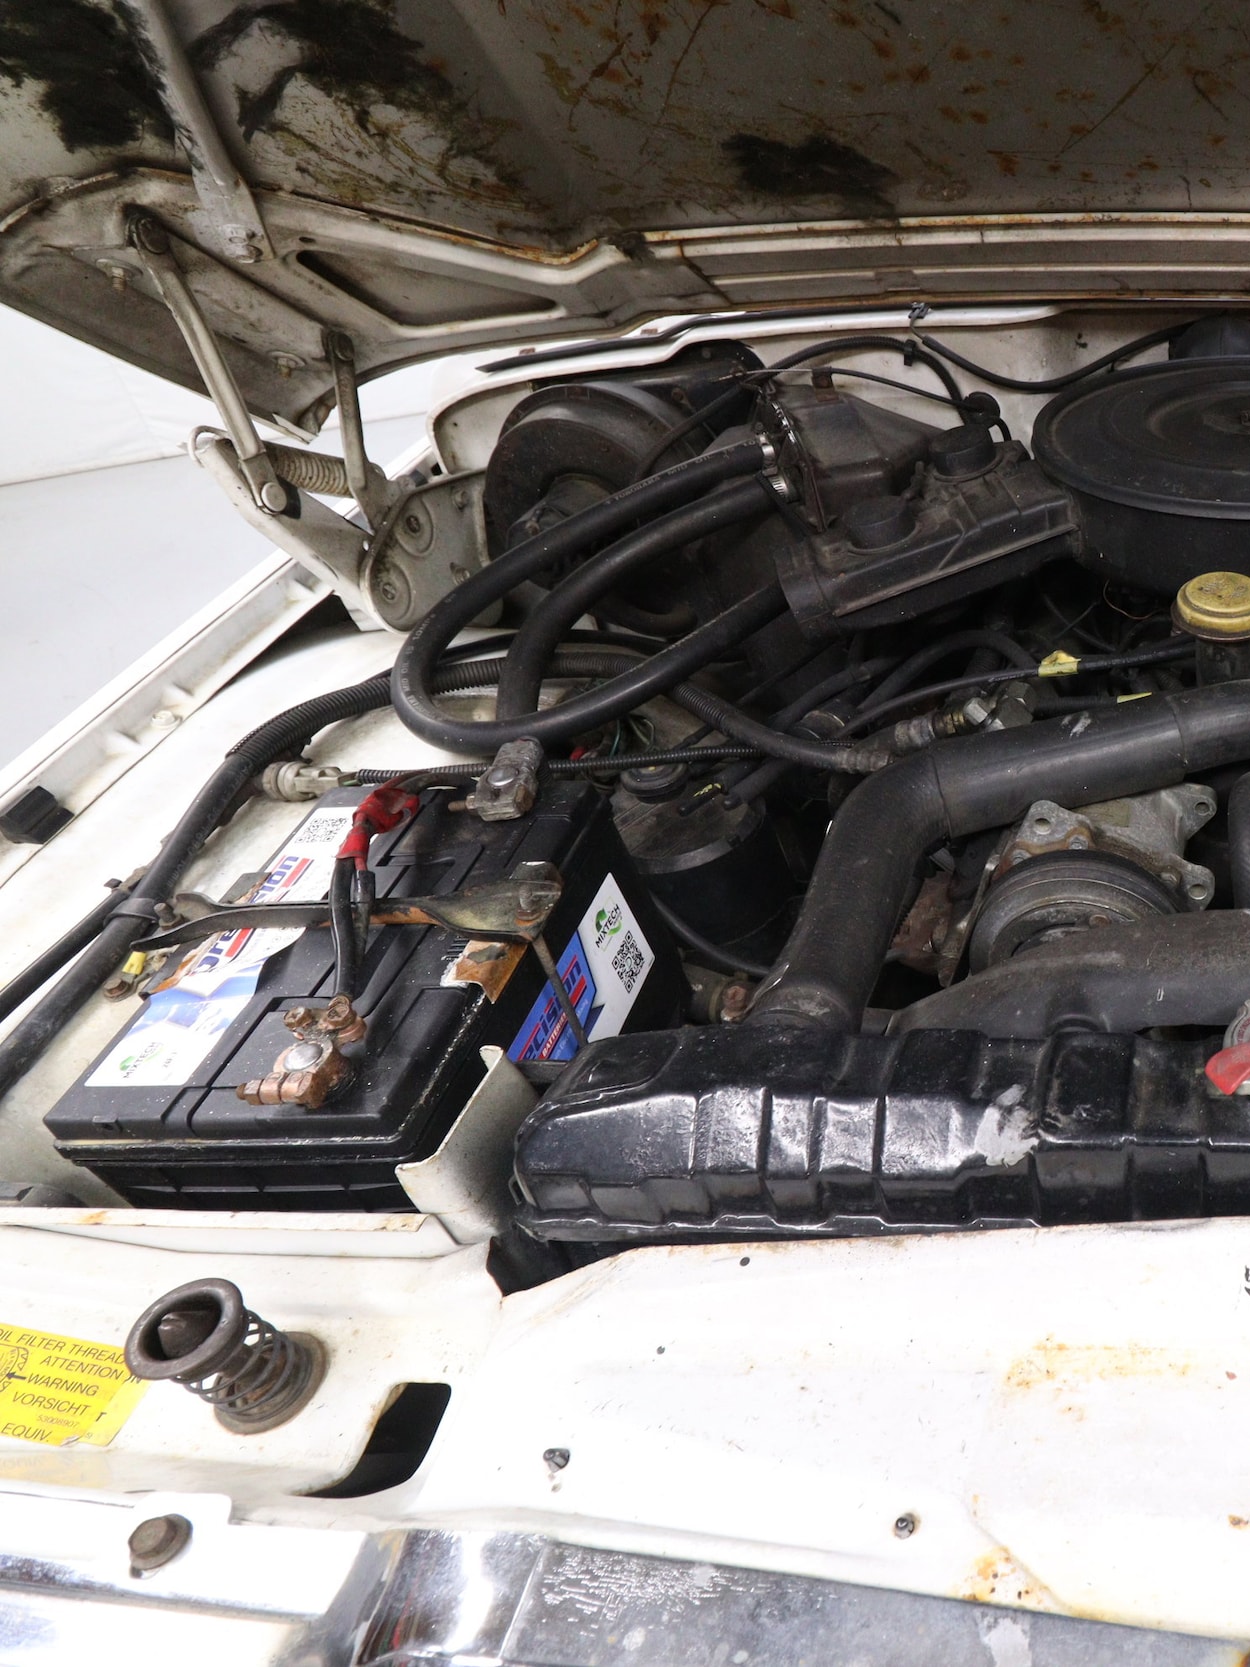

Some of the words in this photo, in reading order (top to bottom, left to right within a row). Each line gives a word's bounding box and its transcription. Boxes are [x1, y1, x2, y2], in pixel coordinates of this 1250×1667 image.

[594, 903, 621, 949] MIXTECH
[122, 1041, 158, 1079] MIXTECH
[16, 1334, 66, 1352] FILTER
[40, 1355, 124, 1380] ATTENTION
[27, 1372, 100, 1397] WARNING
[12, 1391, 91, 1416] VORSICHT
